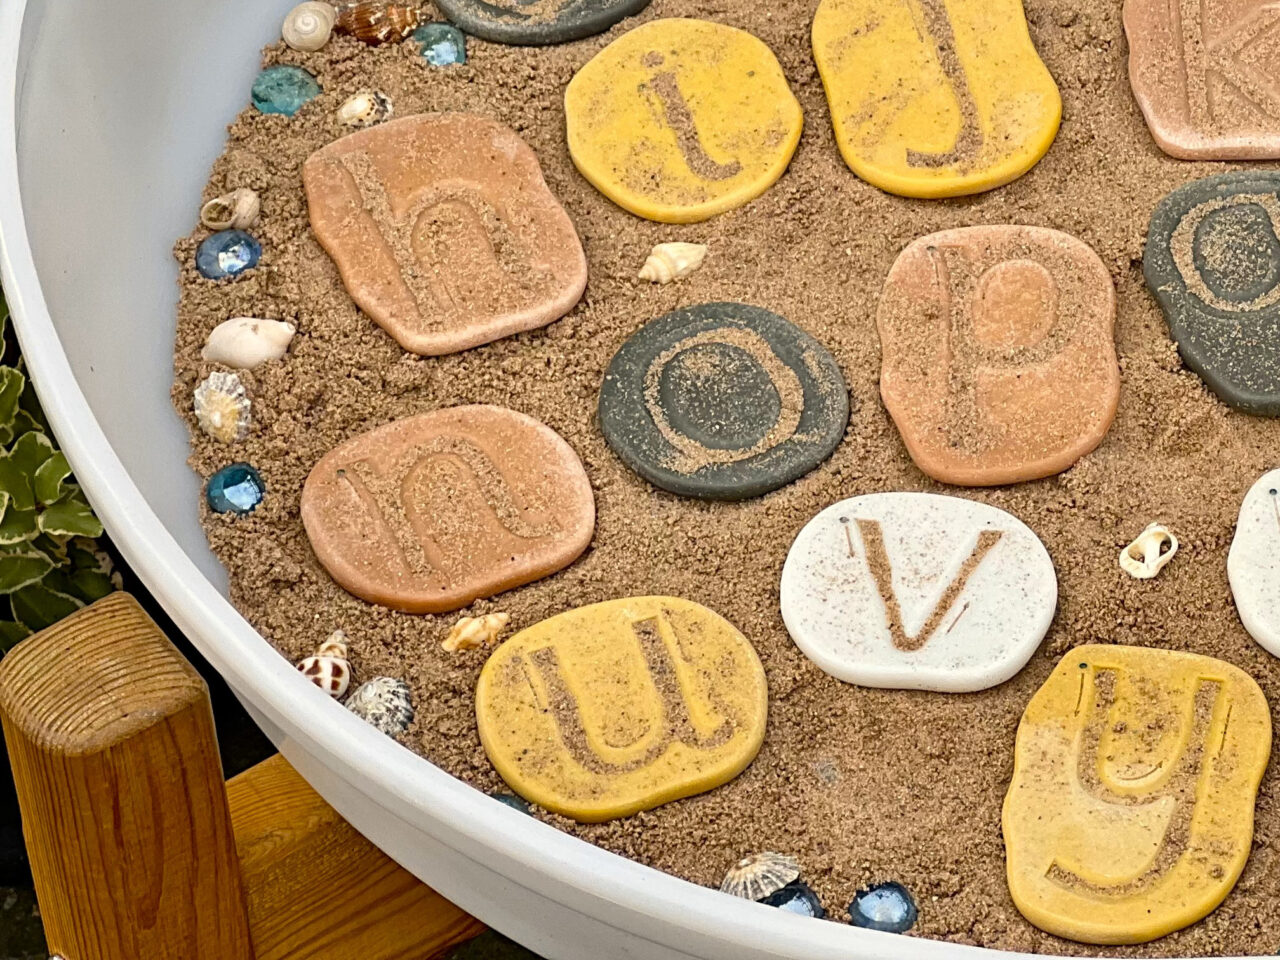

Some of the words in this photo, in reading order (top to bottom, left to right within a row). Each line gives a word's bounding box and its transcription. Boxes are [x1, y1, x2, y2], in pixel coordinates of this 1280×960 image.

[641, 51, 740, 180] i
[336, 152, 553, 332] h
[938, 245, 1085, 452] p
[352, 435, 561, 577] n
[530, 615, 735, 775] u
[1045, 666, 1224, 899] y
